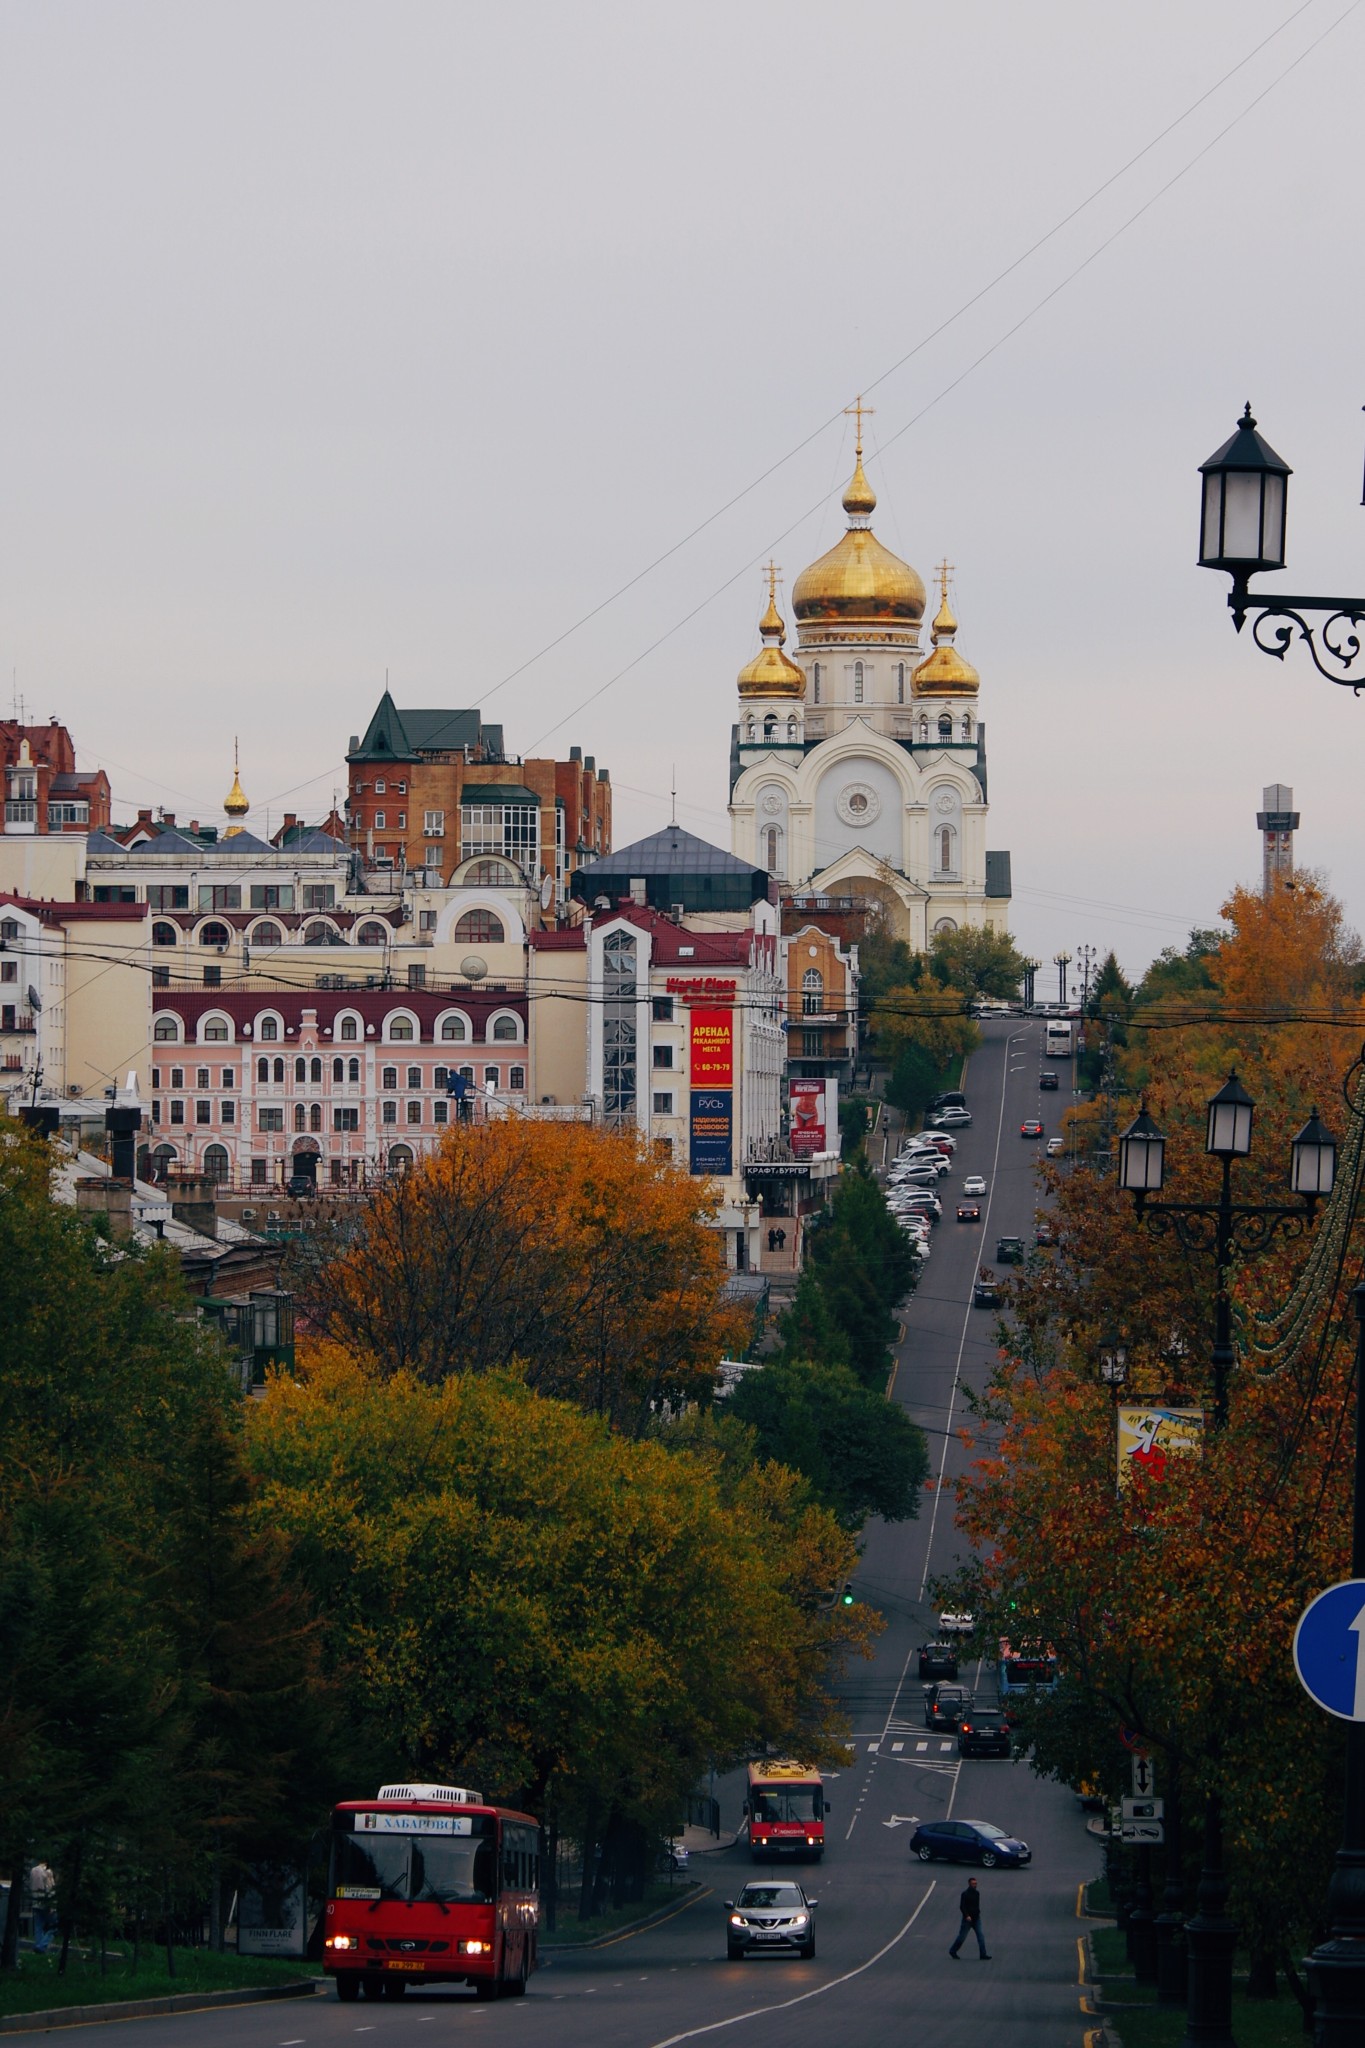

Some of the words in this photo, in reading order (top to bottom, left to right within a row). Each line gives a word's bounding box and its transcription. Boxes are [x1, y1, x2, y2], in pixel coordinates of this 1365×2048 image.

[666, 977, 703, 993] World
[704, 977, 737, 993] Class
[693, 1026, 730, 1037] АРЕНДА
[692, 1037, 731, 1045] РЕКЛАМНОГО
[702, 1045, 721, 1053] МЕСТА
[698, 1099, 724, 1109] РУСЬ
[692, 1123, 729, 1131] правовое
[384, 1817, 462, 1831] ХАБАРОВСК
[249, 1929, 268, 1938] FINN
[269, 1930, 292, 1939] FLARE
